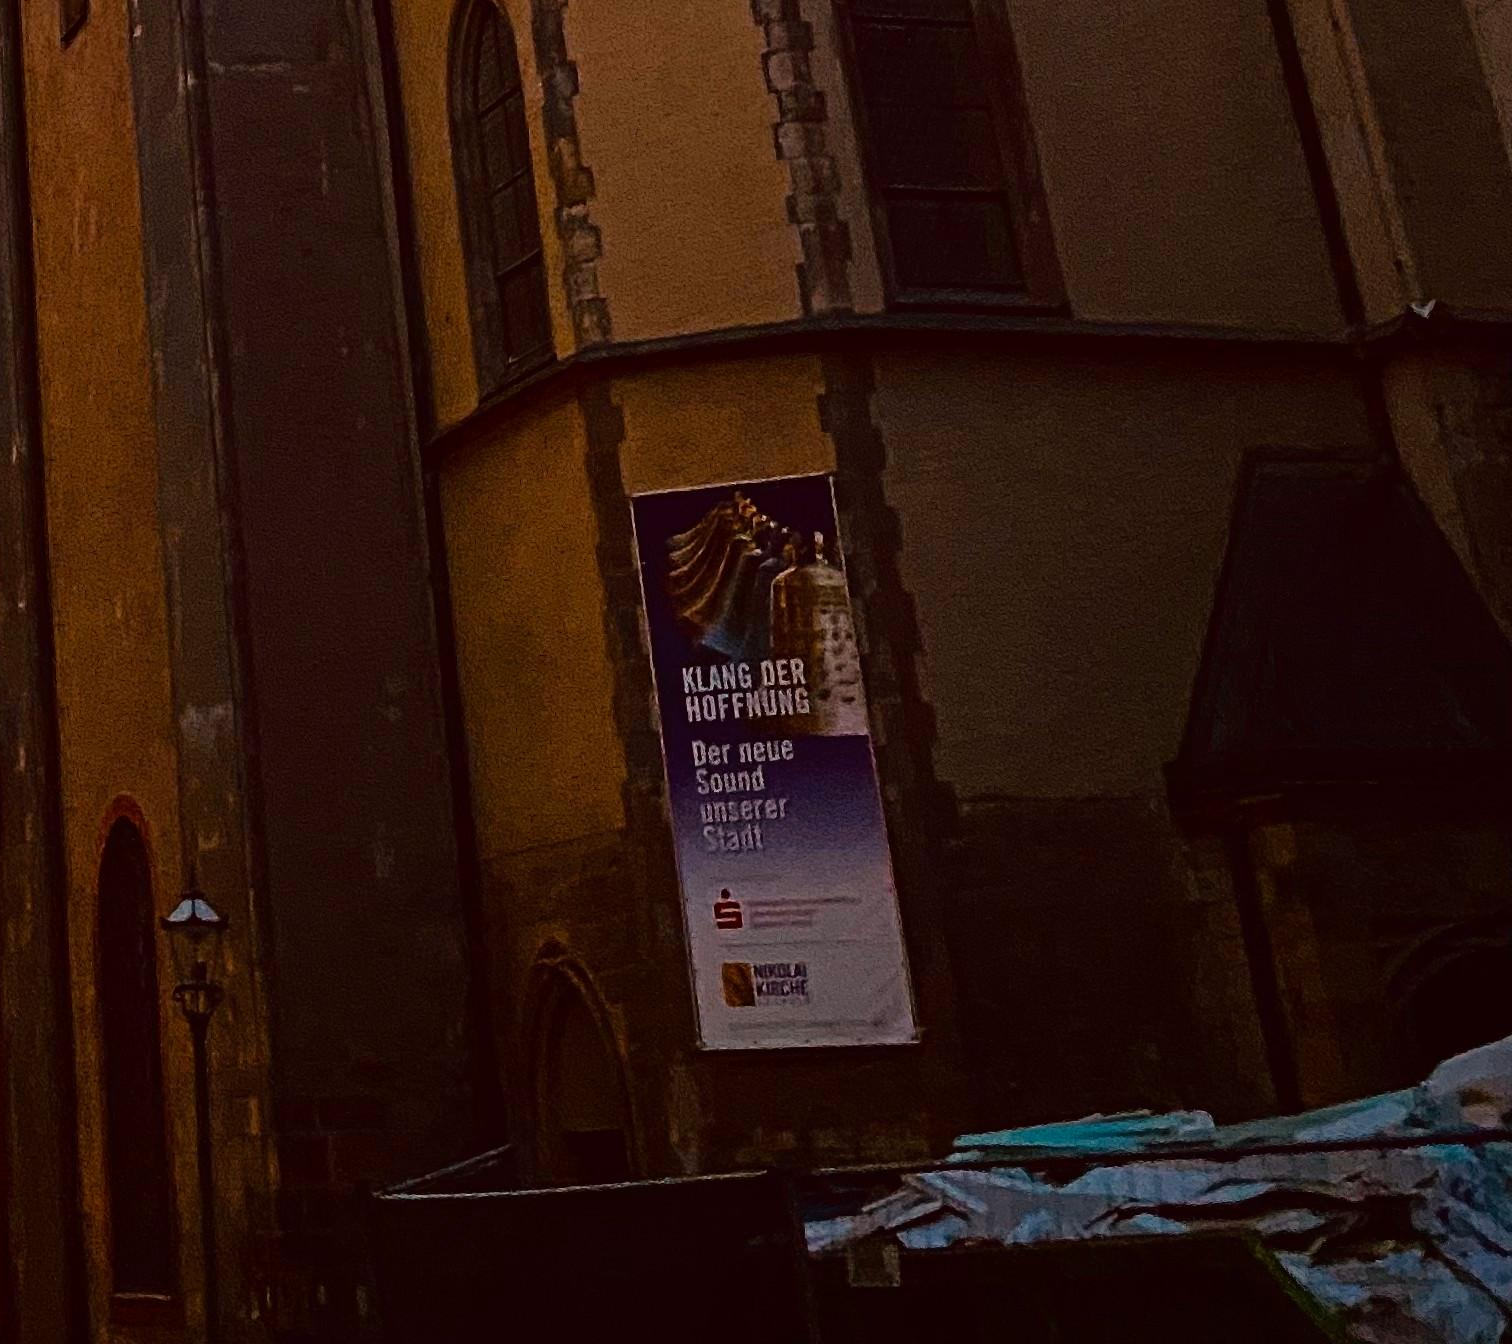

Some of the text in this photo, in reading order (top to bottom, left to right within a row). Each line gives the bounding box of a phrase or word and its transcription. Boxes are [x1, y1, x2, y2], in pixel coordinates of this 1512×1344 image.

[682, 657, 806, 694] KLANG DER
[685, 687, 810, 723] HOFFNUNG
[692, 739, 794, 767] Der neue
[696, 764, 766, 795] Sound
[700, 798, 788, 824] unserer
[703, 823, 763, 851] Stadt
[753, 963, 807, 978] NIKOLAI
[756, 979, 808, 996] KIRCHE
